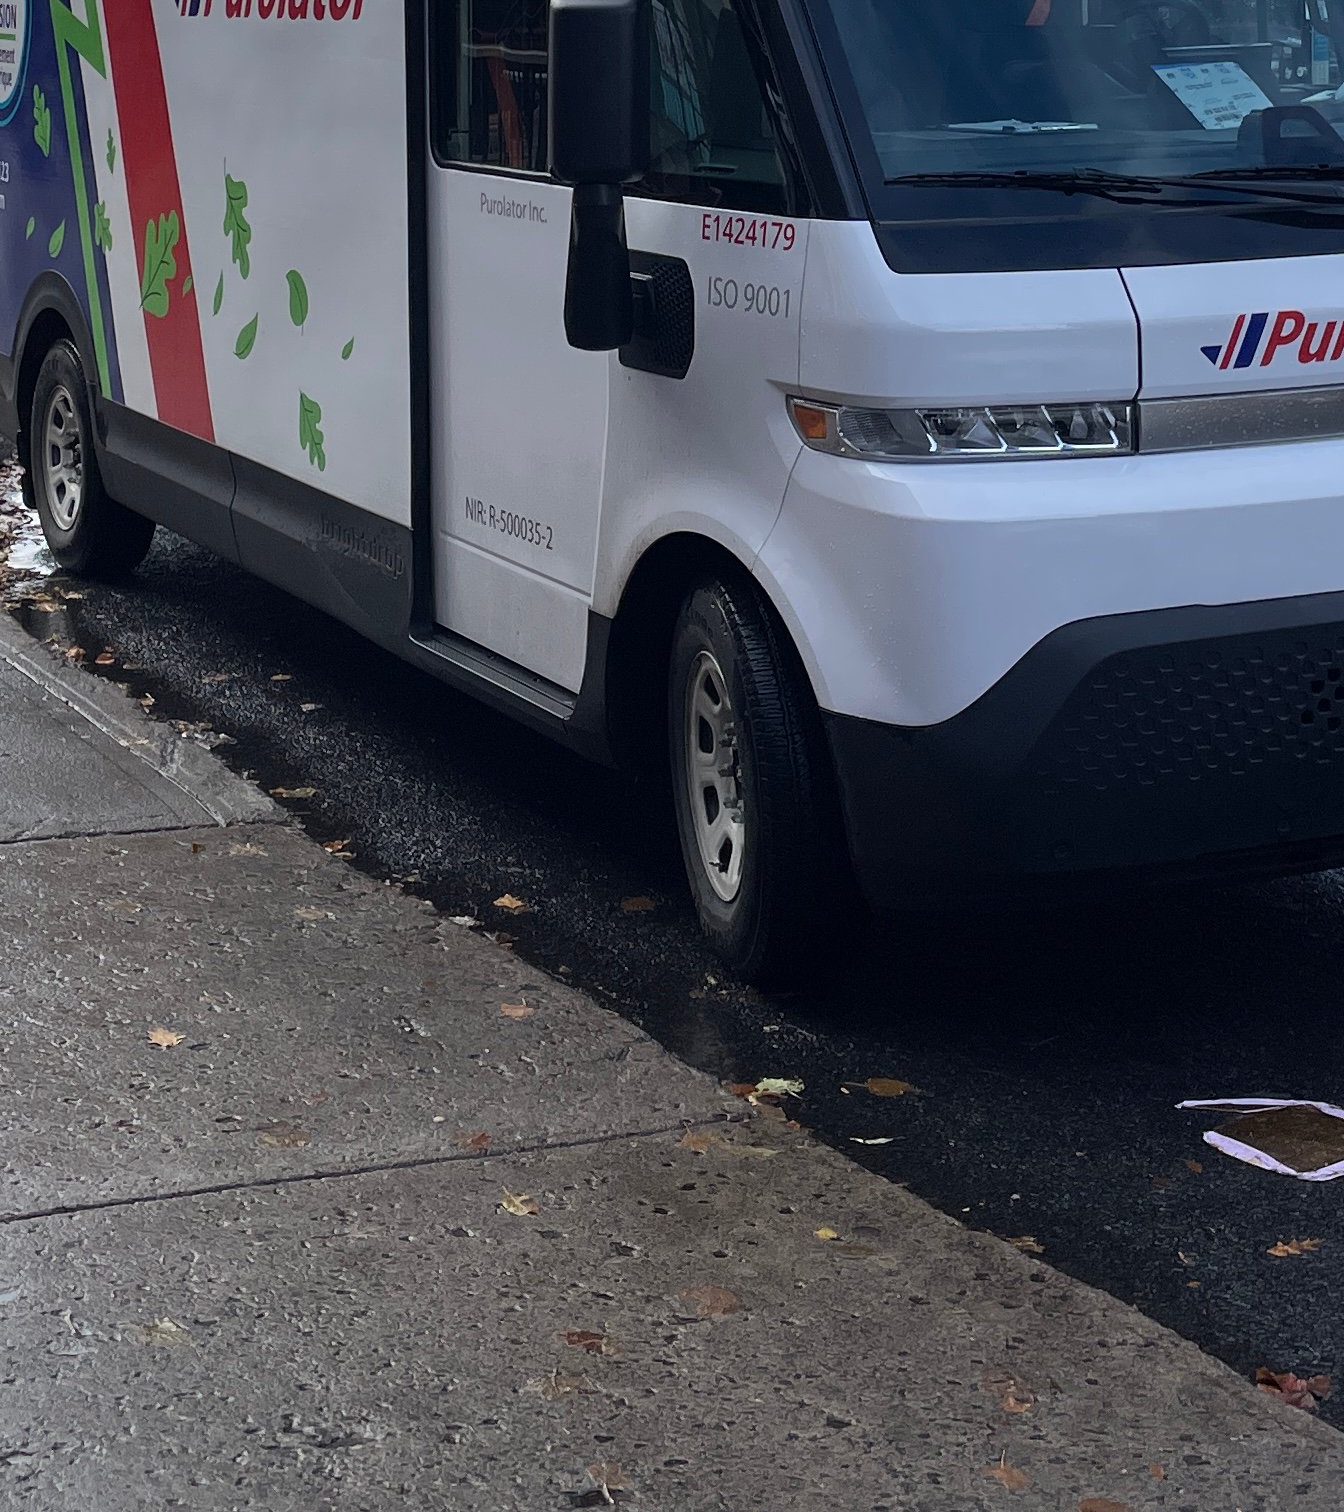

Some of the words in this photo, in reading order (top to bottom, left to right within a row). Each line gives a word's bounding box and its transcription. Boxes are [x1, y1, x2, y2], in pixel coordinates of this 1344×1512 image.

[480, 192, 527, 219] Purolator
[528, 199, 548, 223] Inc.
[702, 213, 795, 251] E1424179
[708, 276, 738, 309] ISO
[744, 283, 791, 319] 9001
[465, 495, 487, 526] NIR:
[489, 504, 554, 551] R-500035-2
